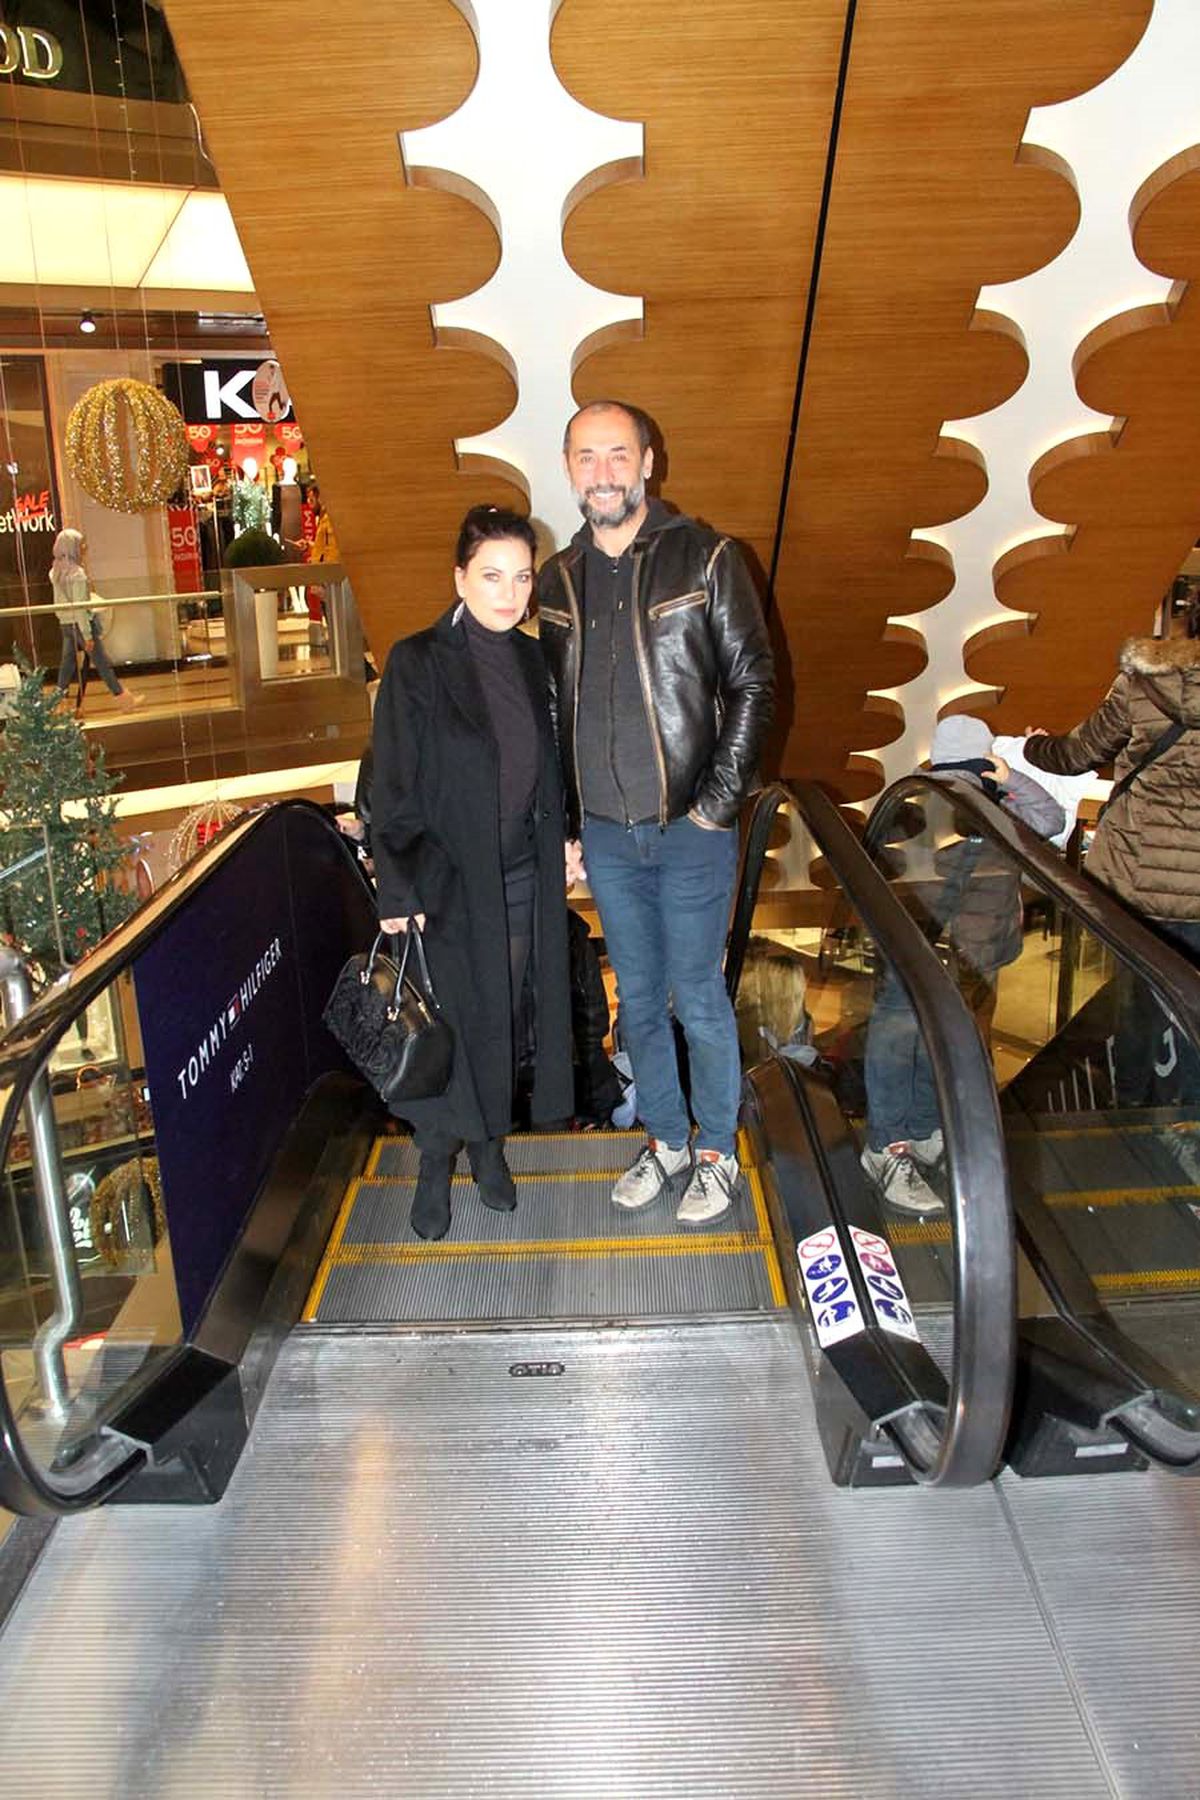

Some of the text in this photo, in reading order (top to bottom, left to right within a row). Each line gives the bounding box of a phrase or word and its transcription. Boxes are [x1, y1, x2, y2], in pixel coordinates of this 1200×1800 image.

[188, 425, 211, 439] 50
[15, 489, 50, 511] SALE
[171, 525, 197, 548] 50
[177, 937, 282, 1099] TOMMY HILFIGER
